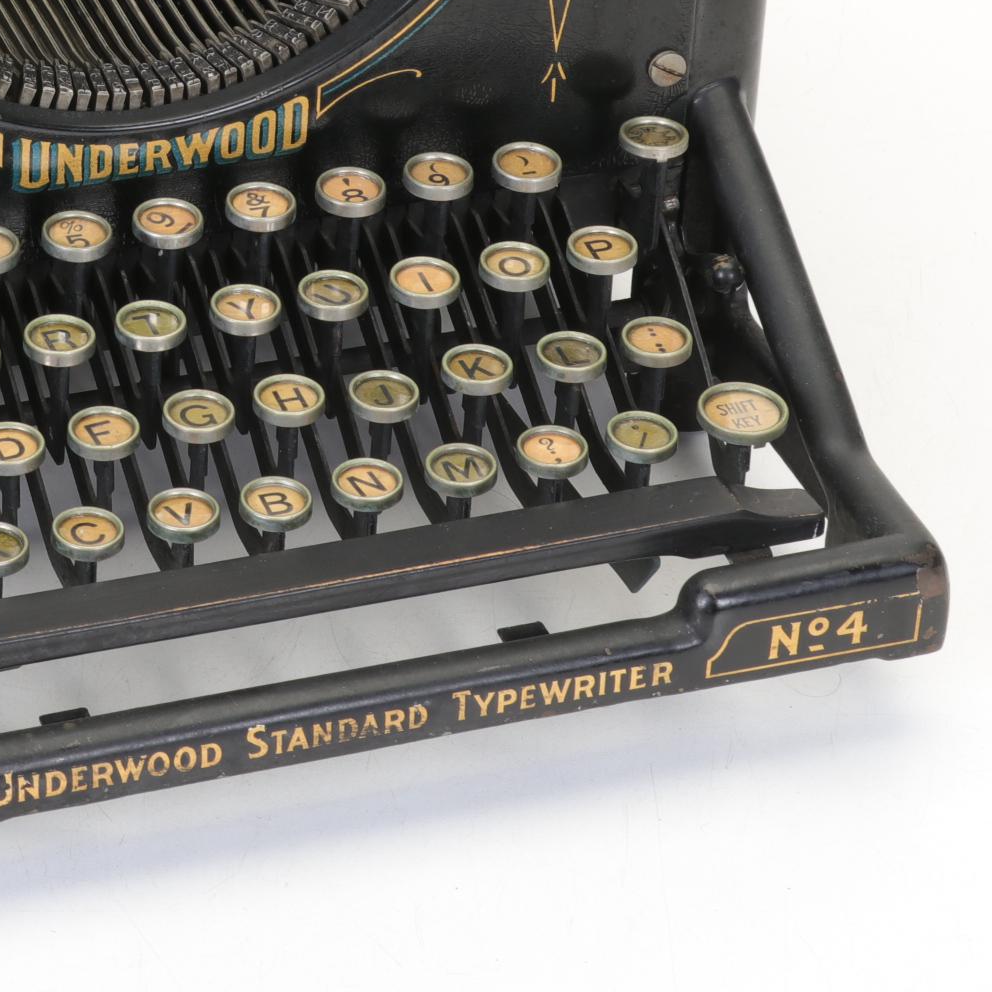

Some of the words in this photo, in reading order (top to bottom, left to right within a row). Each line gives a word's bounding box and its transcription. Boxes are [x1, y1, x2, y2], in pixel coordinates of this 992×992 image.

[11, 95, 309, 193] UNDERWOOD
[342, 188, 369, 203] 8
[66, 233, 91, 248] 5
[583, 239, 613, 260] P
[498, 255, 532, 277] O
[226, 297, 256, 321] Y
[458, 356, 496, 381] K
[271, 387, 309, 412] H
[715, 398, 760, 417] SHIFT
[179, 404, 219, 427] G
[732, 414, 762, 430] KEY
[83, 420, 112, 446] F
[440, 457, 484, 482] M
[346, 471, 388, 497] N
[163, 501, 194, 527] V
[258, 491, 294, 517] B
[69, 521, 106, 546] C
[834, 609, 869, 647] 4
[247, 703, 429, 761] STANDARD
[452, 661, 674, 724] TYPEWRITER
